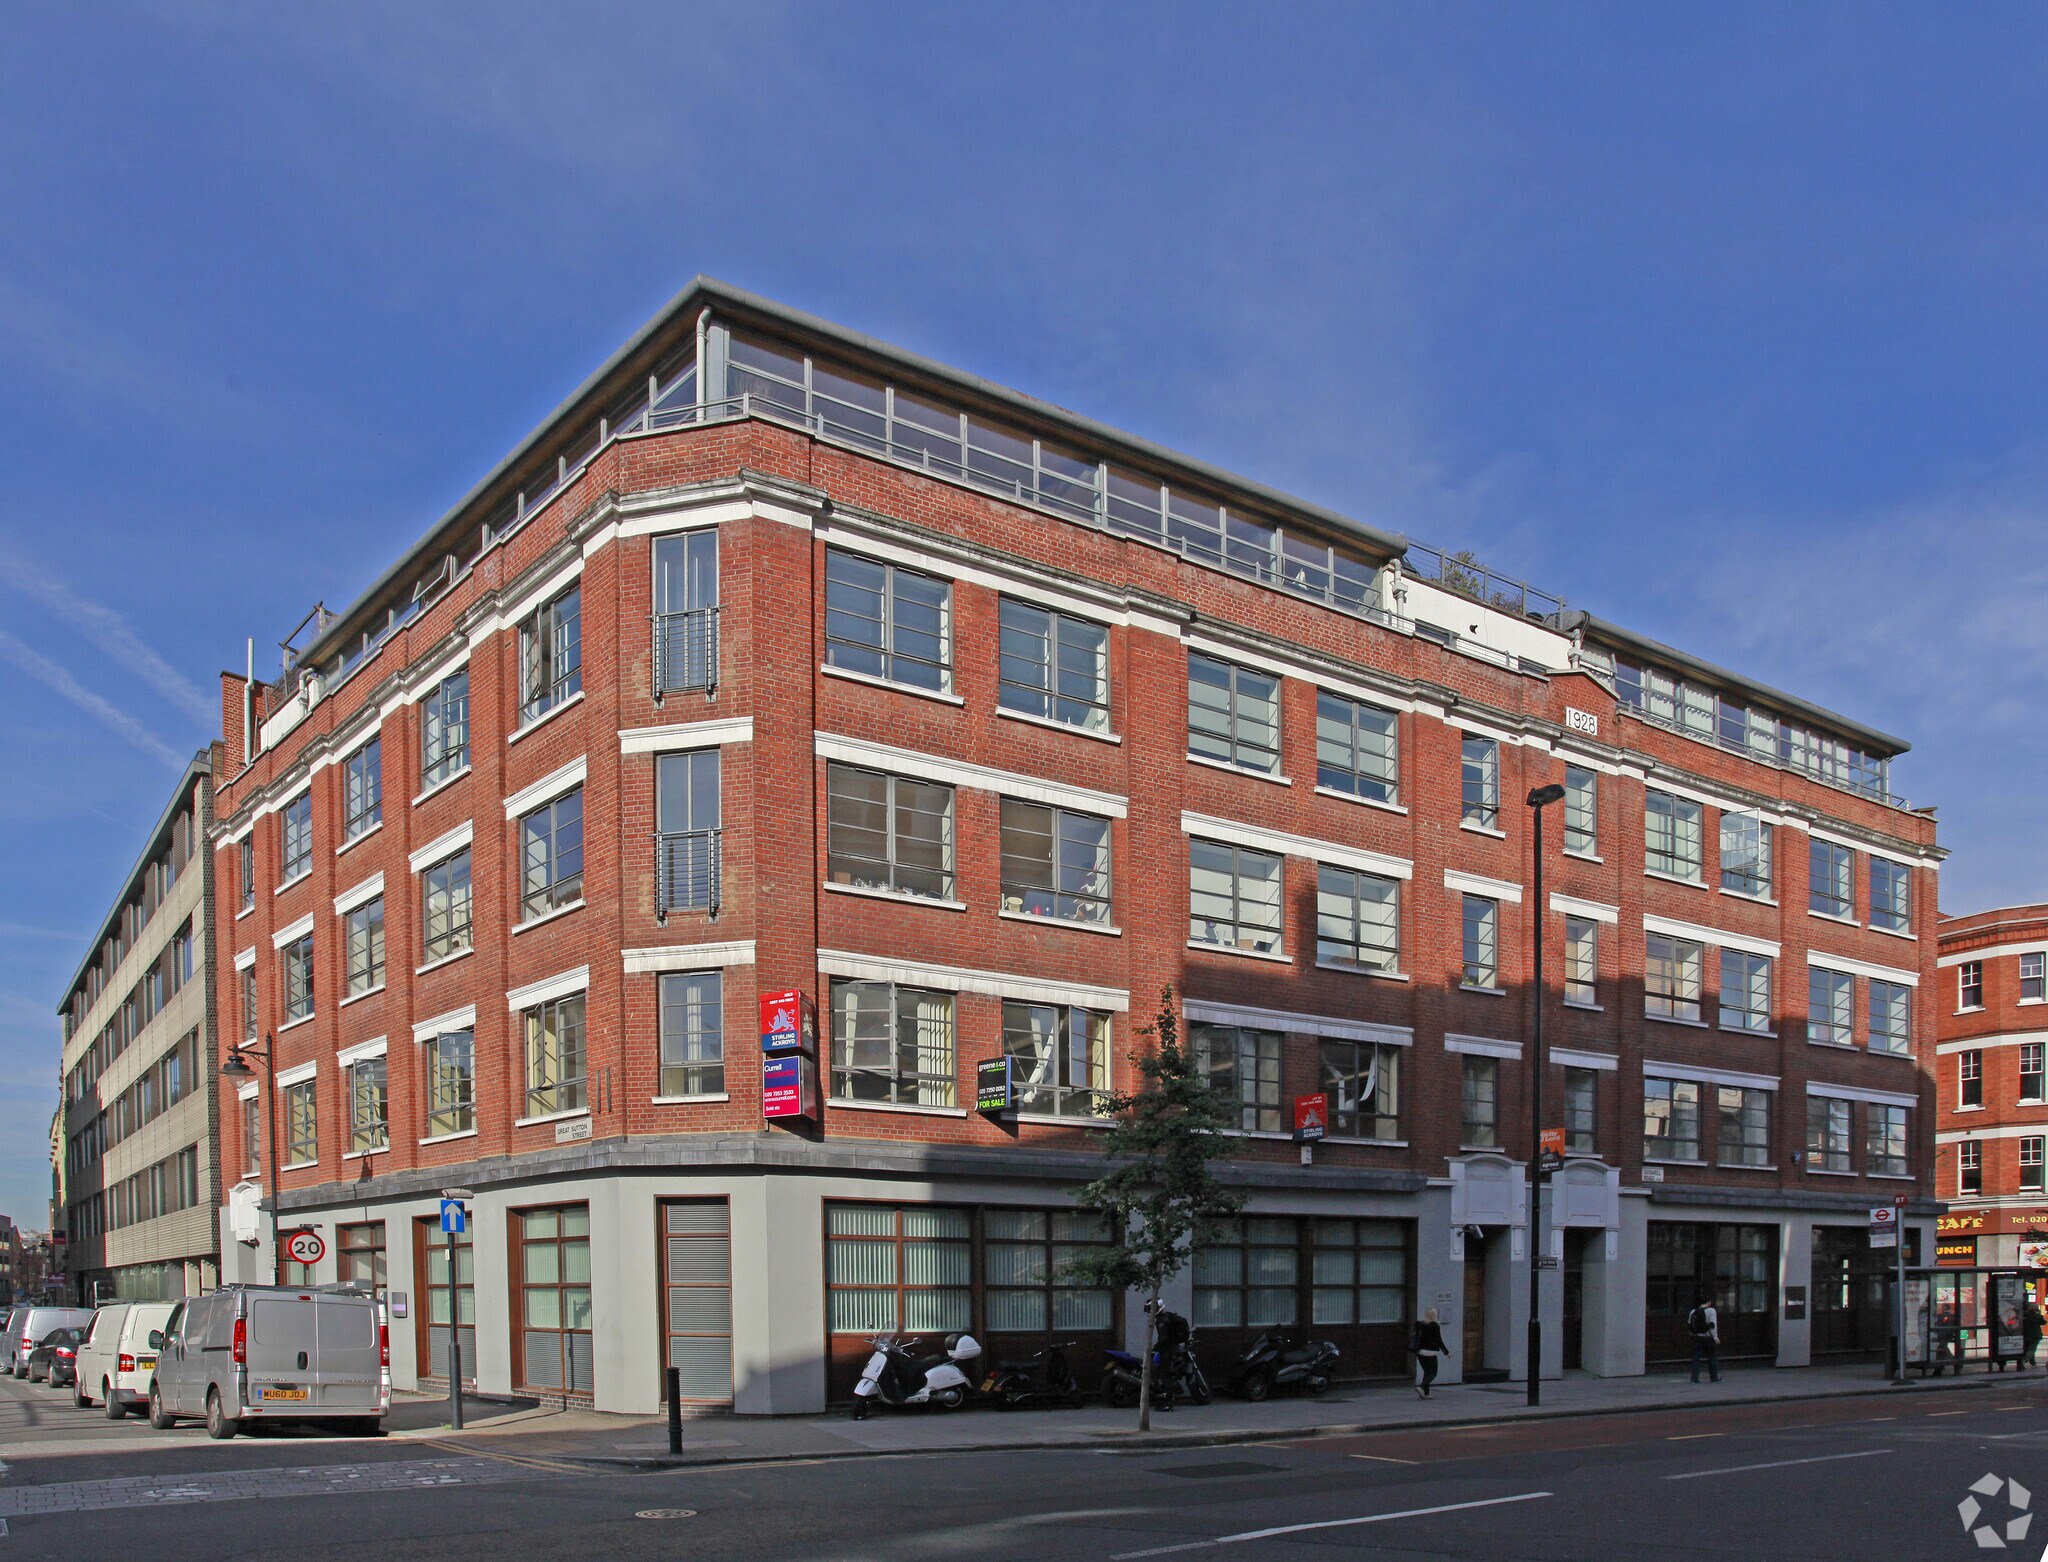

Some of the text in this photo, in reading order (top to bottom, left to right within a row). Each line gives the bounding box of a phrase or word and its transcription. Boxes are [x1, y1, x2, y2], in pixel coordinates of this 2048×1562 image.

[1568, 709, 1596, 734] 1928
[771, 1033, 796, 1041] STIRLING
[771, 1039, 796, 1047] ACKROYD
[764, 1064, 782, 1072] Currell
[979, 1098, 1005, 1109] FOR SALE
[557, 1124, 587, 1135] GREAT SUTTON
[572, 1130, 587, 1139] STREET
[1895, 1196, 1906, 1204] BT
[2011, 1216, 2028, 1224] Tel.
[294, 1241, 320, 1255] 20
